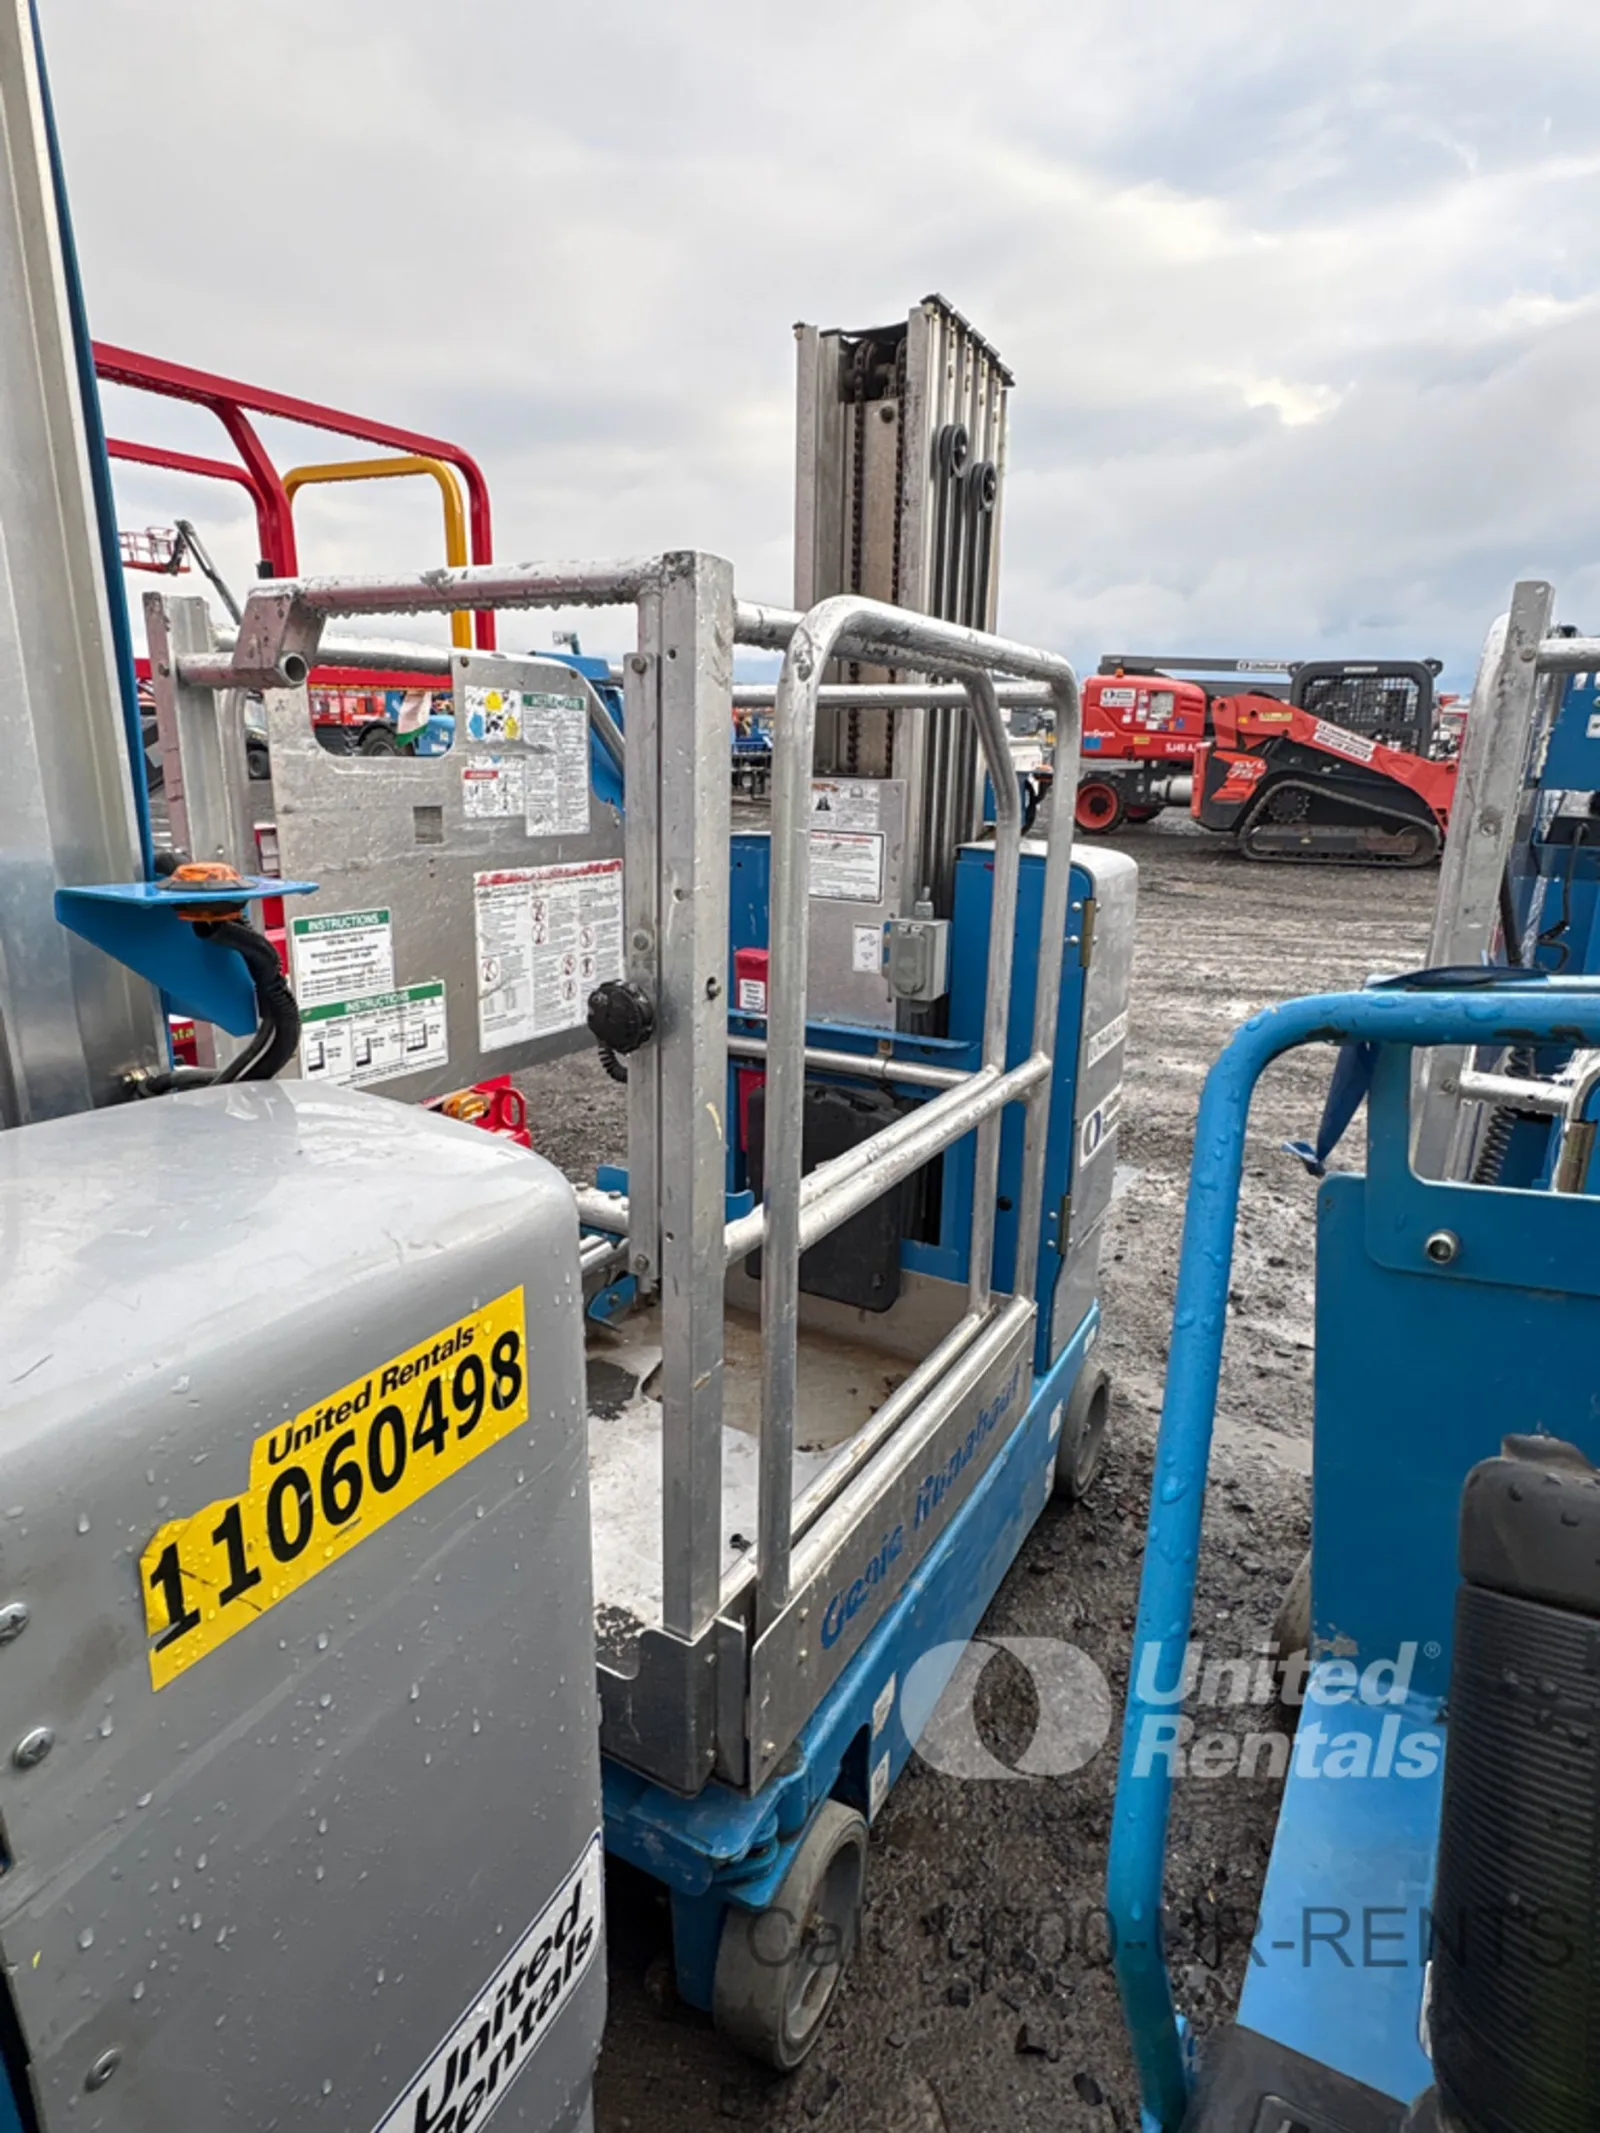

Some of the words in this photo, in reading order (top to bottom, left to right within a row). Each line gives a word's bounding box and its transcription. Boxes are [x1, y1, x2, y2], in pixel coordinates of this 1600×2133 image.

[308, 914, 379, 932] INSTRUCTIONS
[344, 991, 410, 1013] INSTRUCTIONS
[267, 1382, 372, 1466] United
[380, 1325, 475, 1400] Rentals
[149, 1329, 523, 1653] 11060498
[414, 1877, 583, 2133] United
